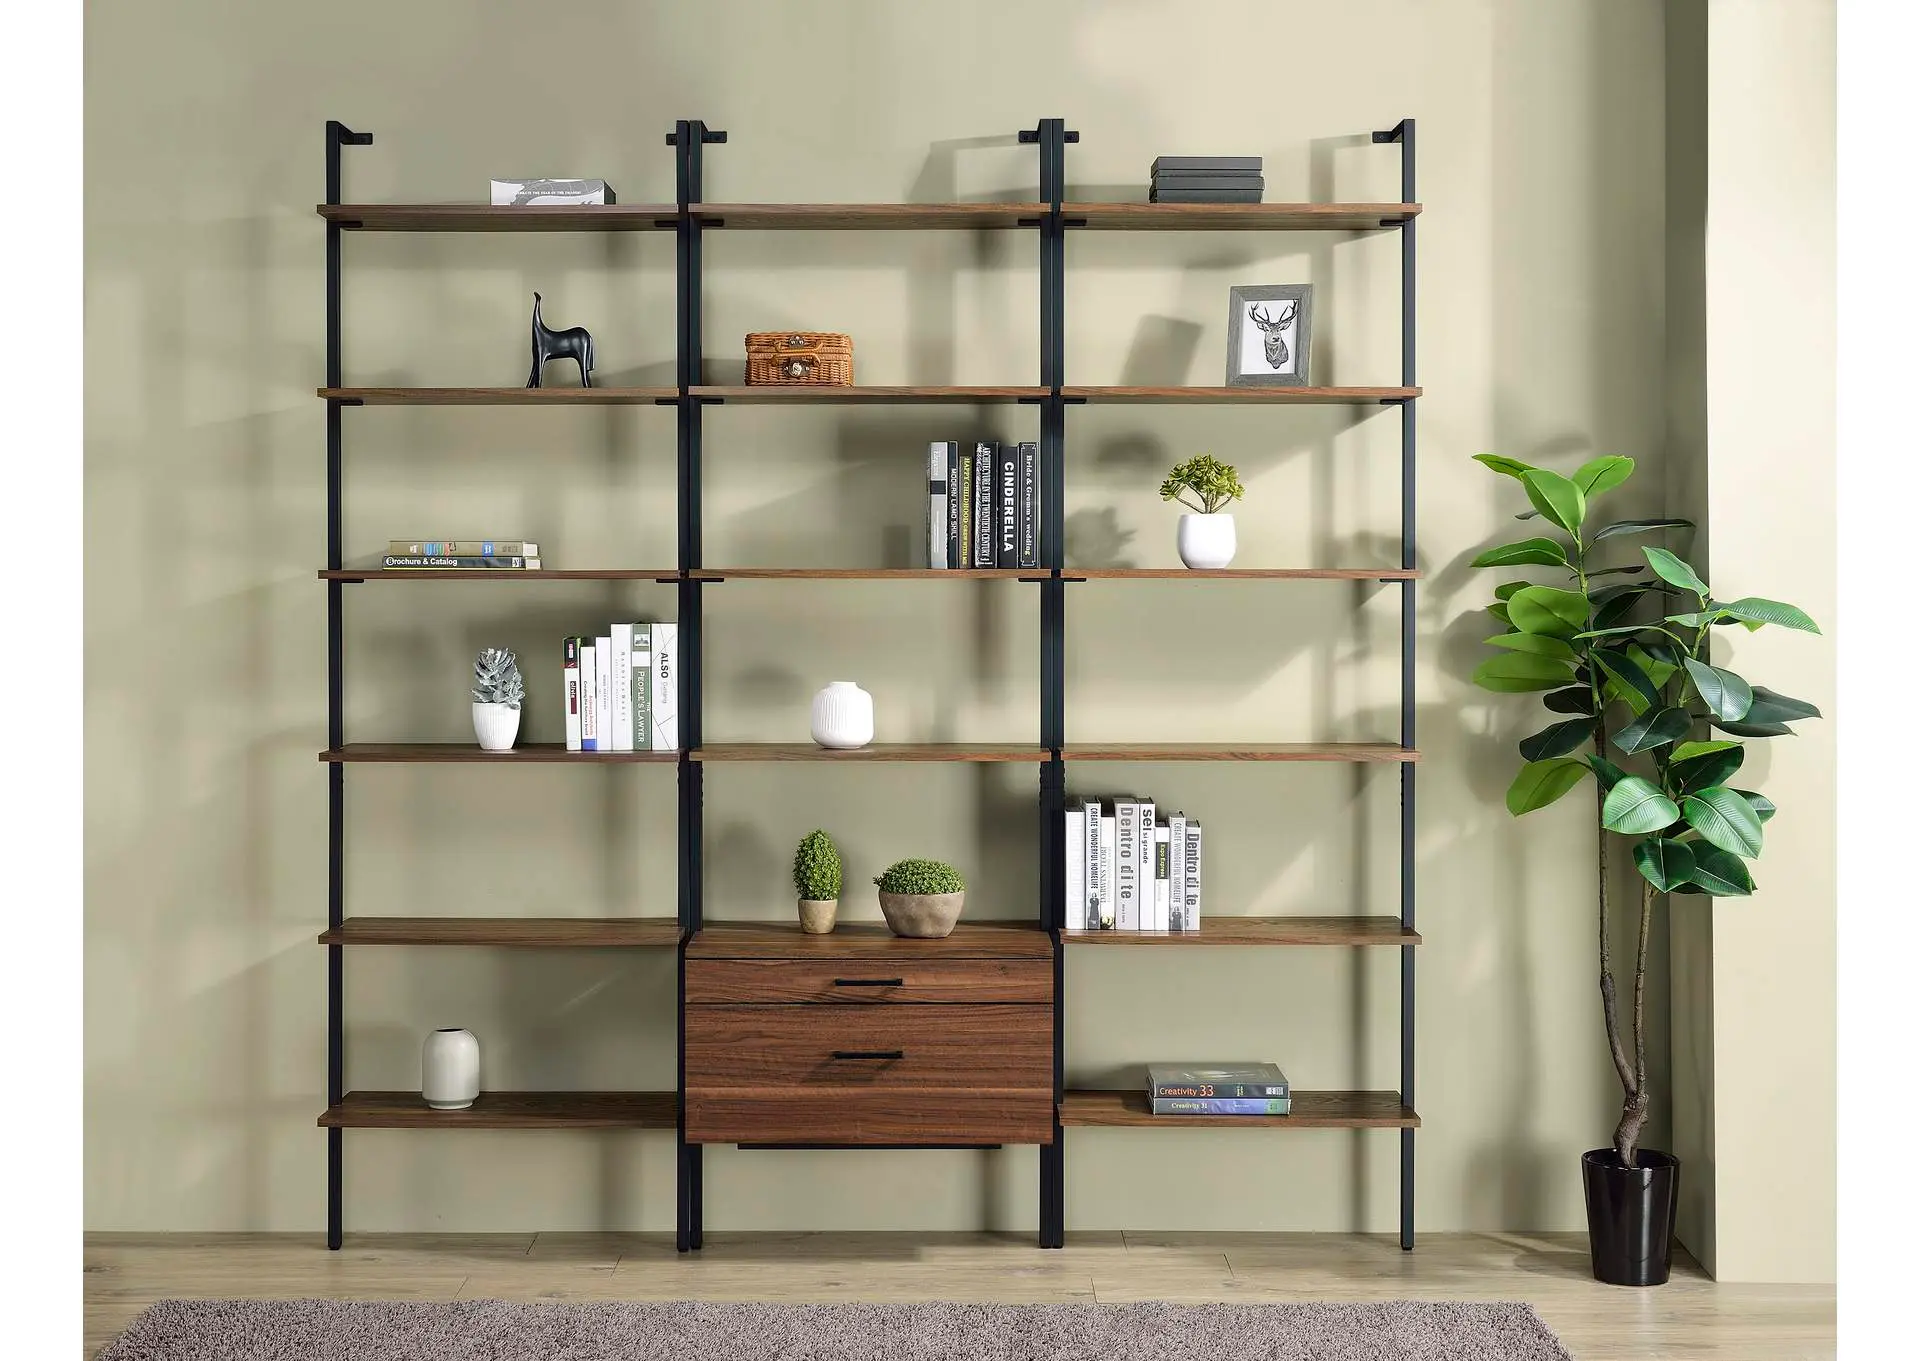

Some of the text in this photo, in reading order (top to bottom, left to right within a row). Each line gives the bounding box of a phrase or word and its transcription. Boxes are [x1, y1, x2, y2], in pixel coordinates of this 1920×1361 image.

[963, 457, 971, 481] HAPPY
[982, 446, 991, 485] ARCHITECTURE
[1025, 454, 1033, 477] Bride
[1026, 478, 1033, 486] &
[982, 493, 991, 502] THE
[1004, 461, 1015, 552] CINDERELLA
[981, 503, 991, 533] TWENTIETH
[981, 533, 991, 556] CENTURY
[1024, 524, 1032, 556] wedding
[386, 557, 458, 567] Brochure & Catalog
[660, 652, 669, 678] ALSO
[637, 671, 645, 742] PEOPLE'S LAWYER
[1090, 807, 1098, 889] CREATE WONDERFUL HOMELIFE
[1120, 807, 1134, 899] Dentro di te
[1173, 822, 1181, 903] CREATE WONDERFUL HOMELIFE
[1186, 833, 1200, 905] Dentro di te
[1160, 1085, 1214, 1097] Creativity 33
[1171, 1102, 1199, 1110] Creativity
